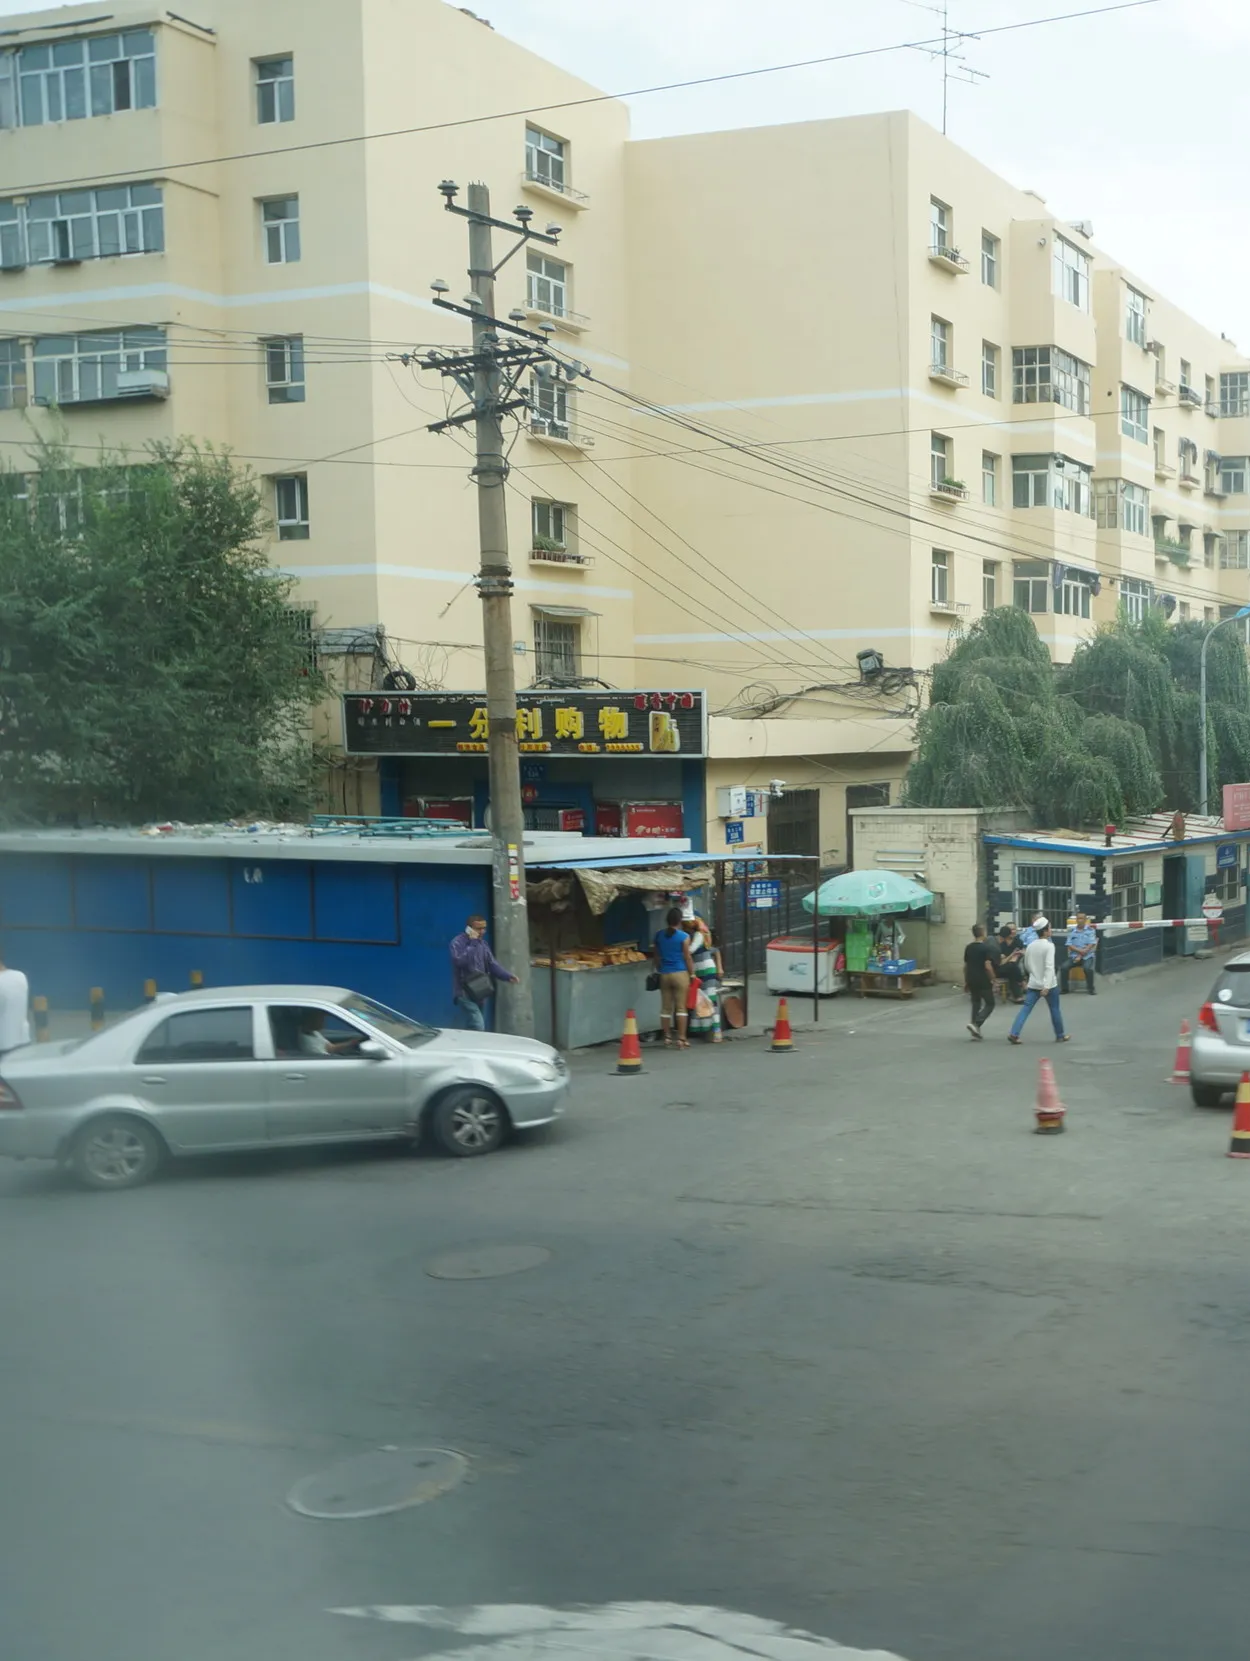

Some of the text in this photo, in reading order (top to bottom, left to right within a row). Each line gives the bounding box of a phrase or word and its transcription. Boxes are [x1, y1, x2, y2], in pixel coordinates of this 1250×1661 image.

[427, 707, 628, 740] 一分利购物
